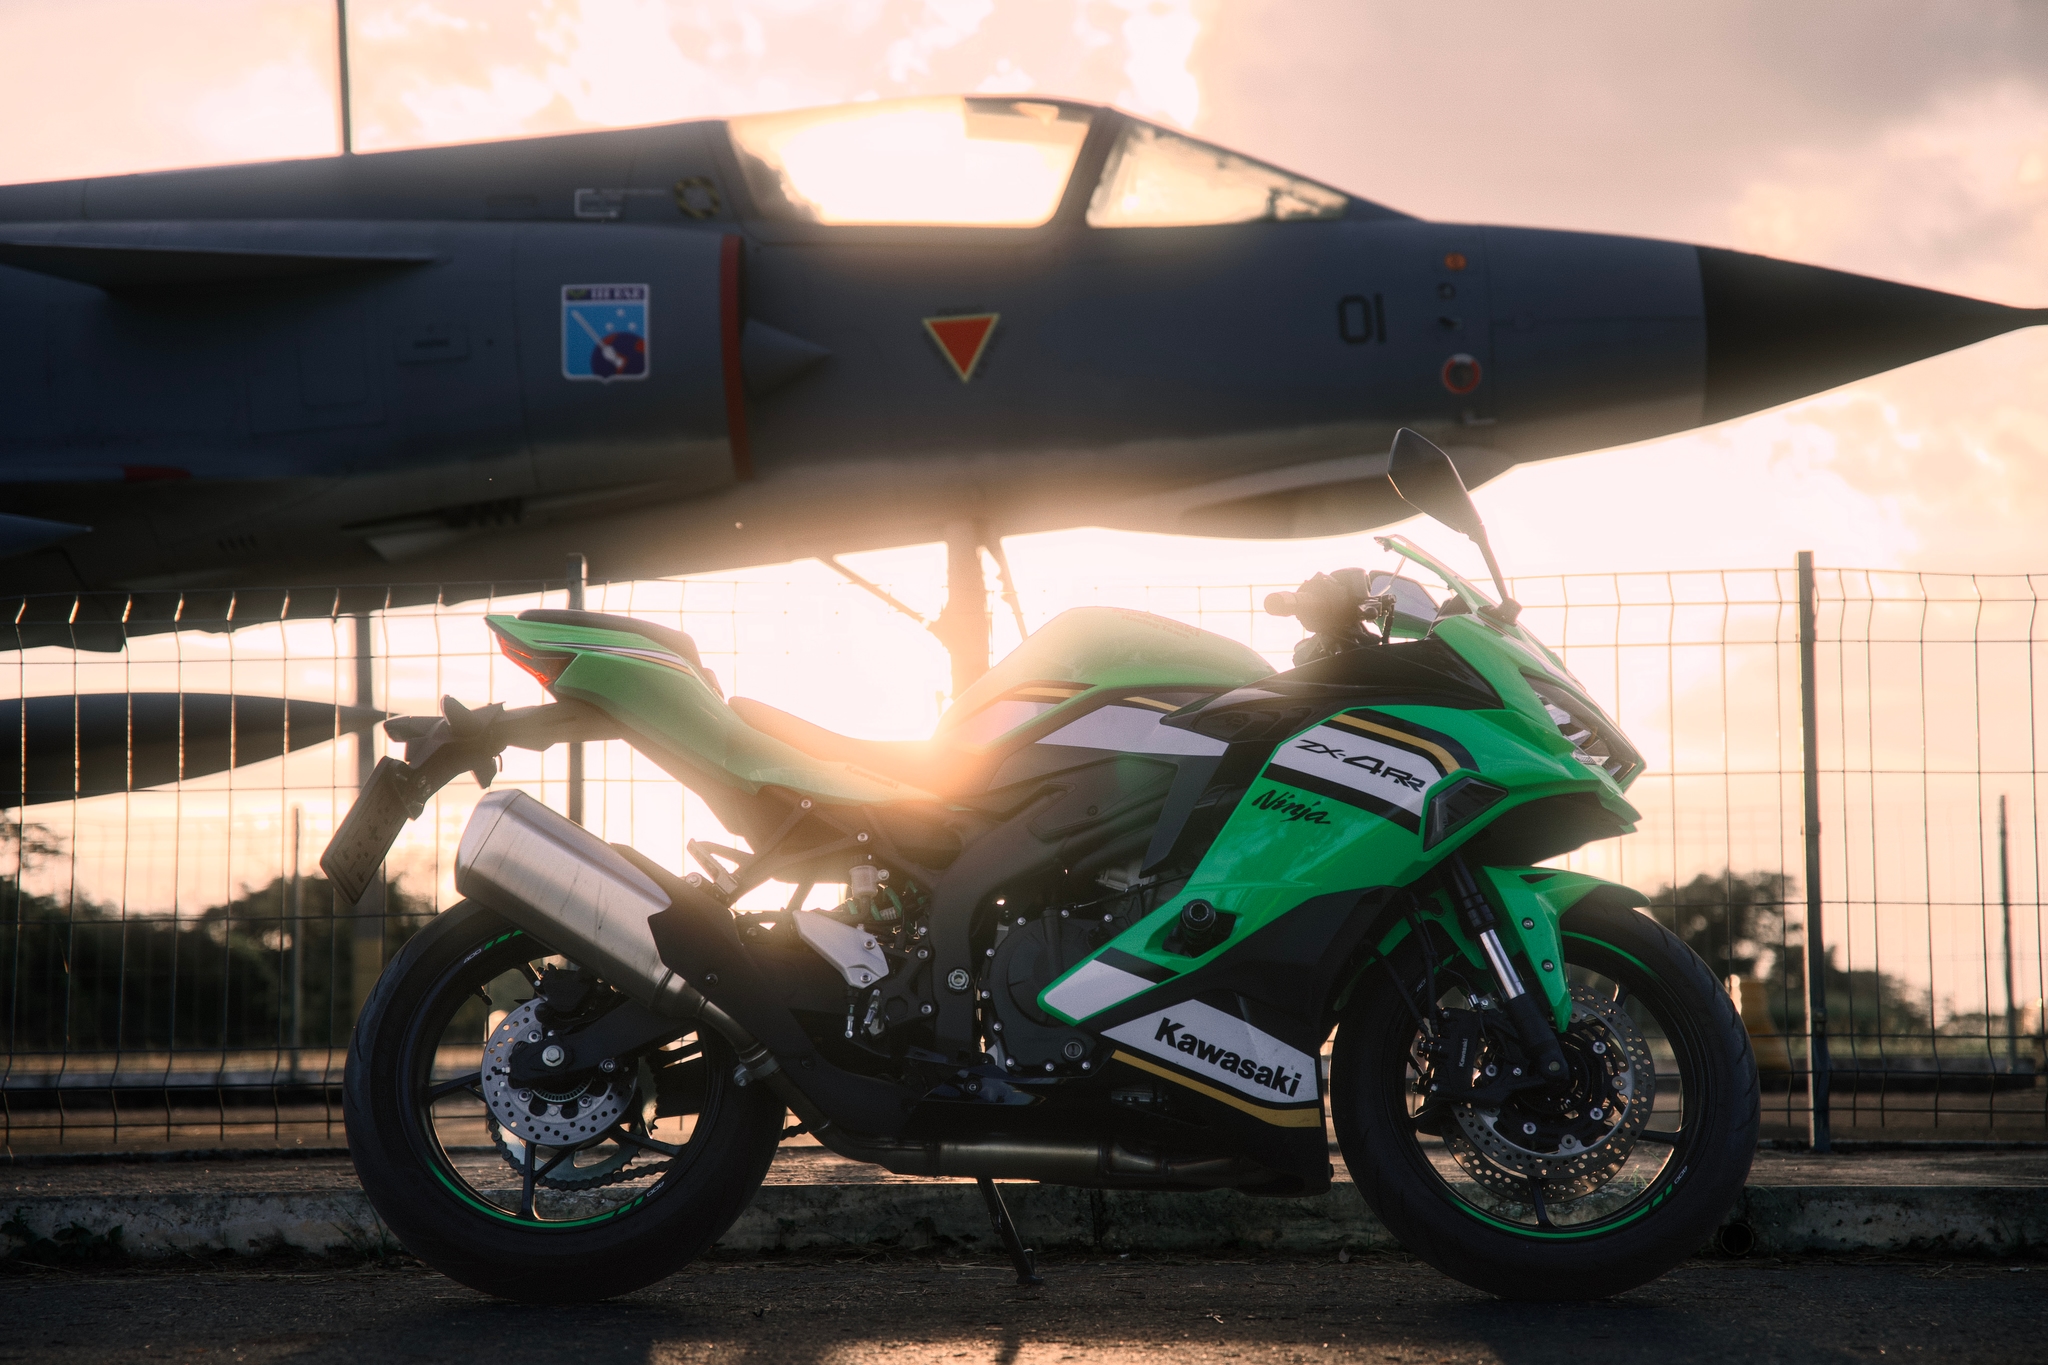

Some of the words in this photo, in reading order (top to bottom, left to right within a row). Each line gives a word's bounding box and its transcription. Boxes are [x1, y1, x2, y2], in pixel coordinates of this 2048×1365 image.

[1336, 293, 1387, 345] 01
[1162, 624, 1190, 640] Team
[1296, 739, 1426, 792] ZX-4RR
[1251, 789, 1331, 824] Ninja
[463, 948, 482, 964] 400
[1154, 1017, 1302, 1097] Kawasaki
[1458, 1038, 1468, 1068] Kawasaki
